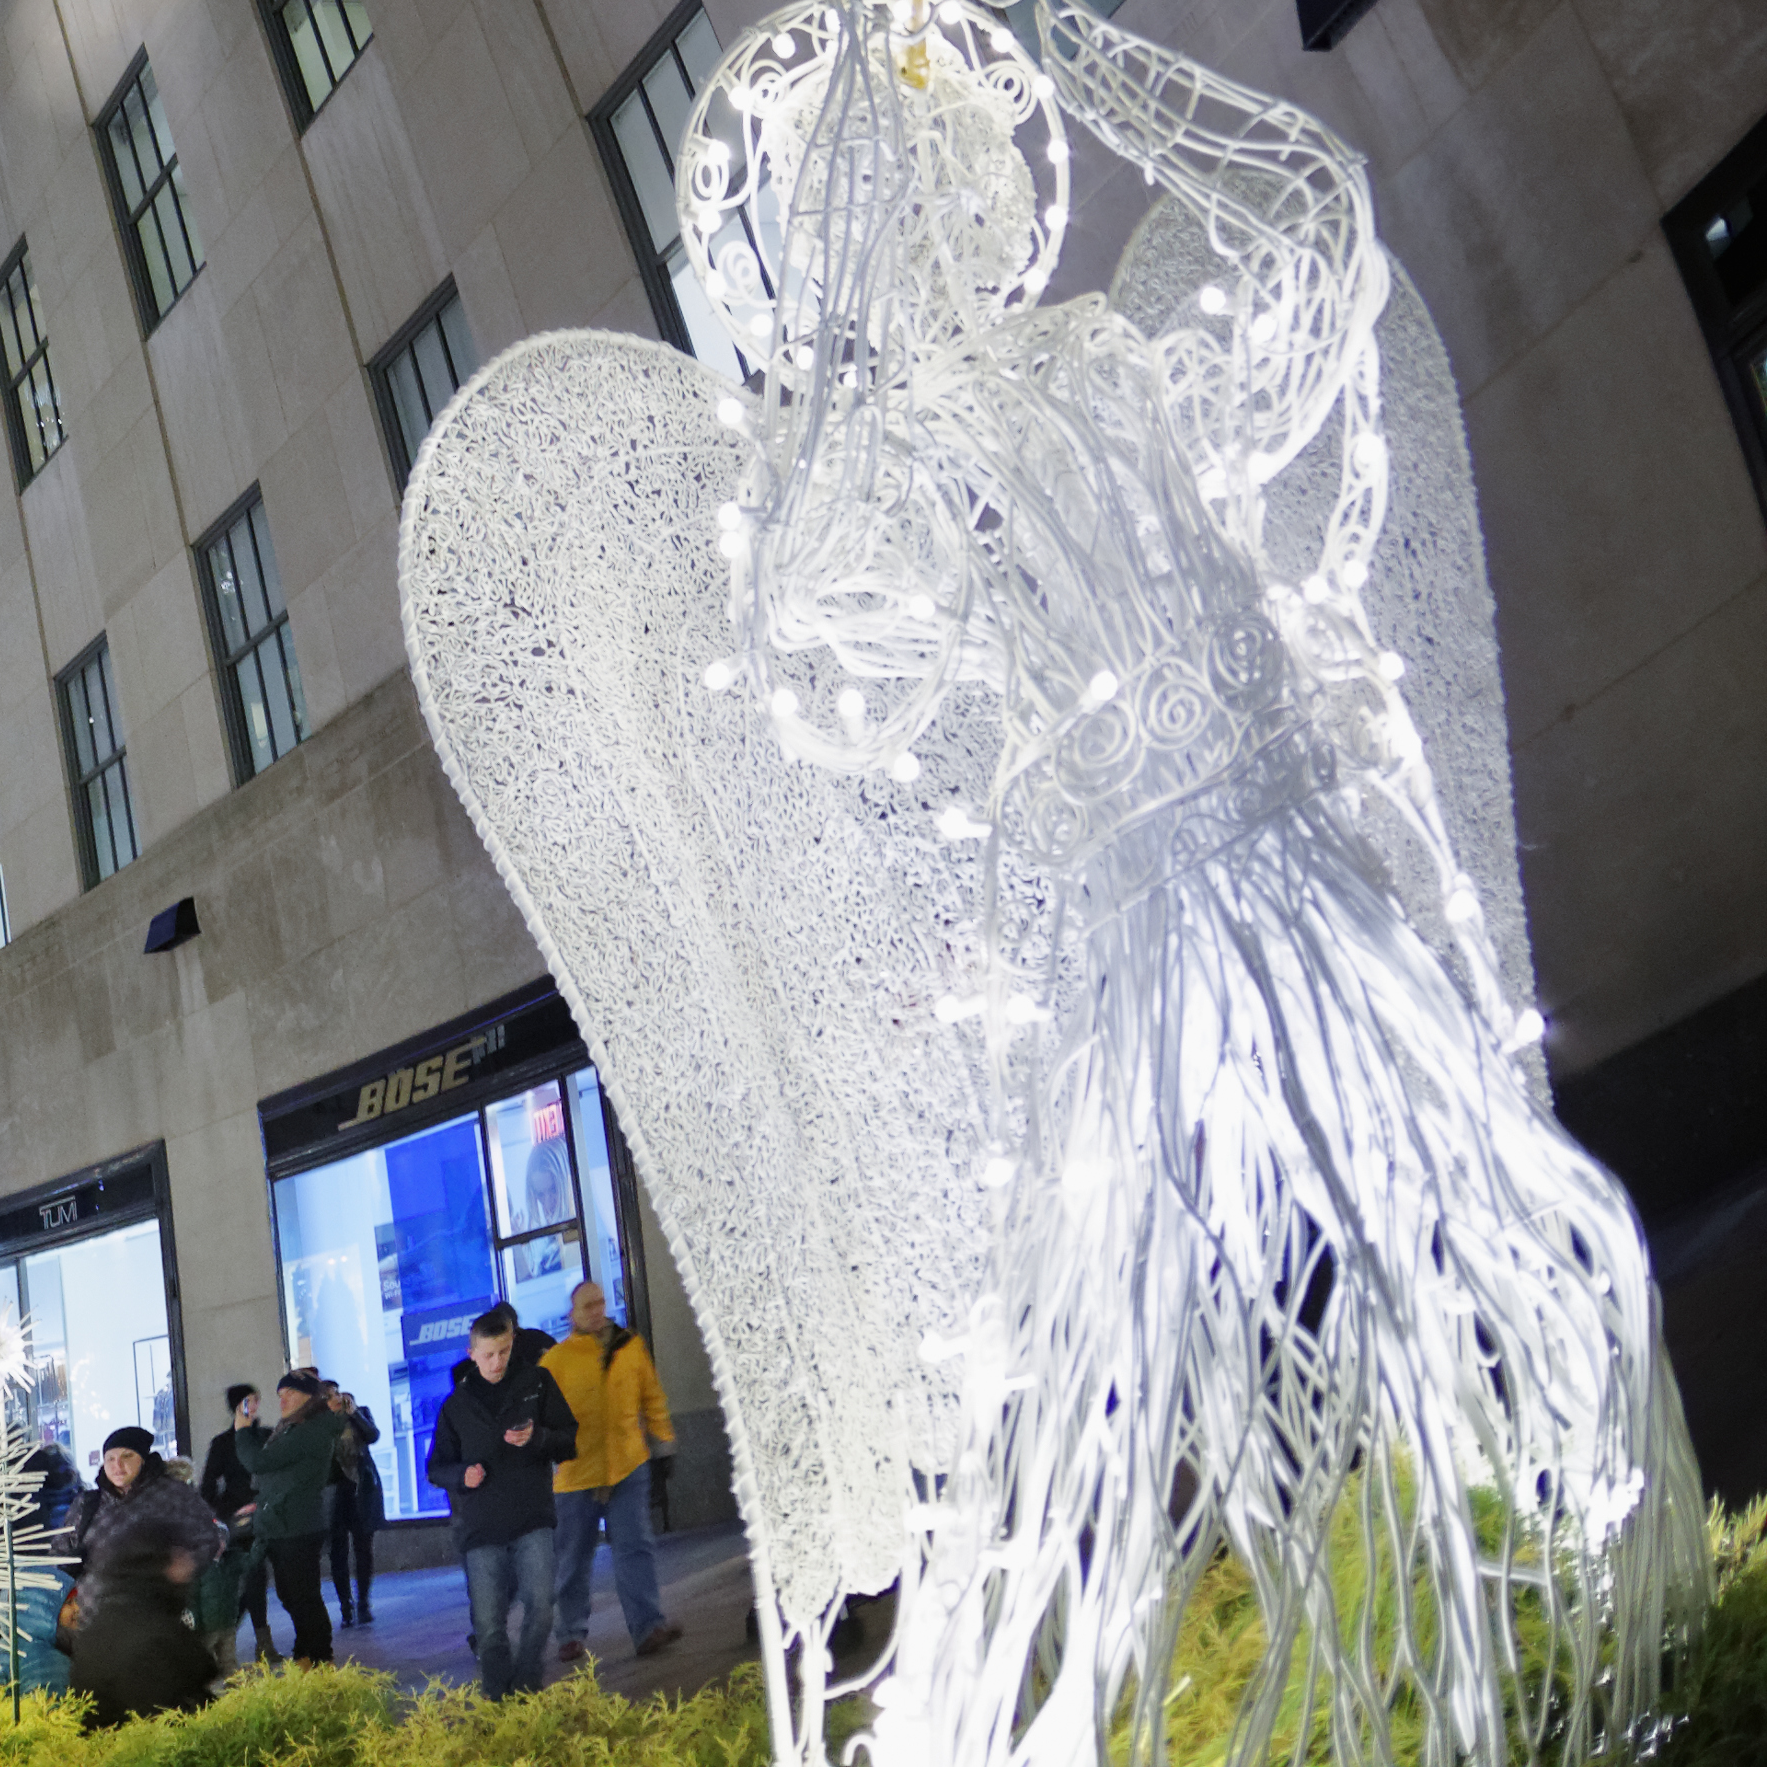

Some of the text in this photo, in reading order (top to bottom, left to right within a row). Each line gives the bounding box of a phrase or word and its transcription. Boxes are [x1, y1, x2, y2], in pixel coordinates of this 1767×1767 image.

[338, 1036, 487, 1131] BOSE
[39, 1195, 78, 1230] TUMI
[409, 1313, 484, 1346] BOSE
